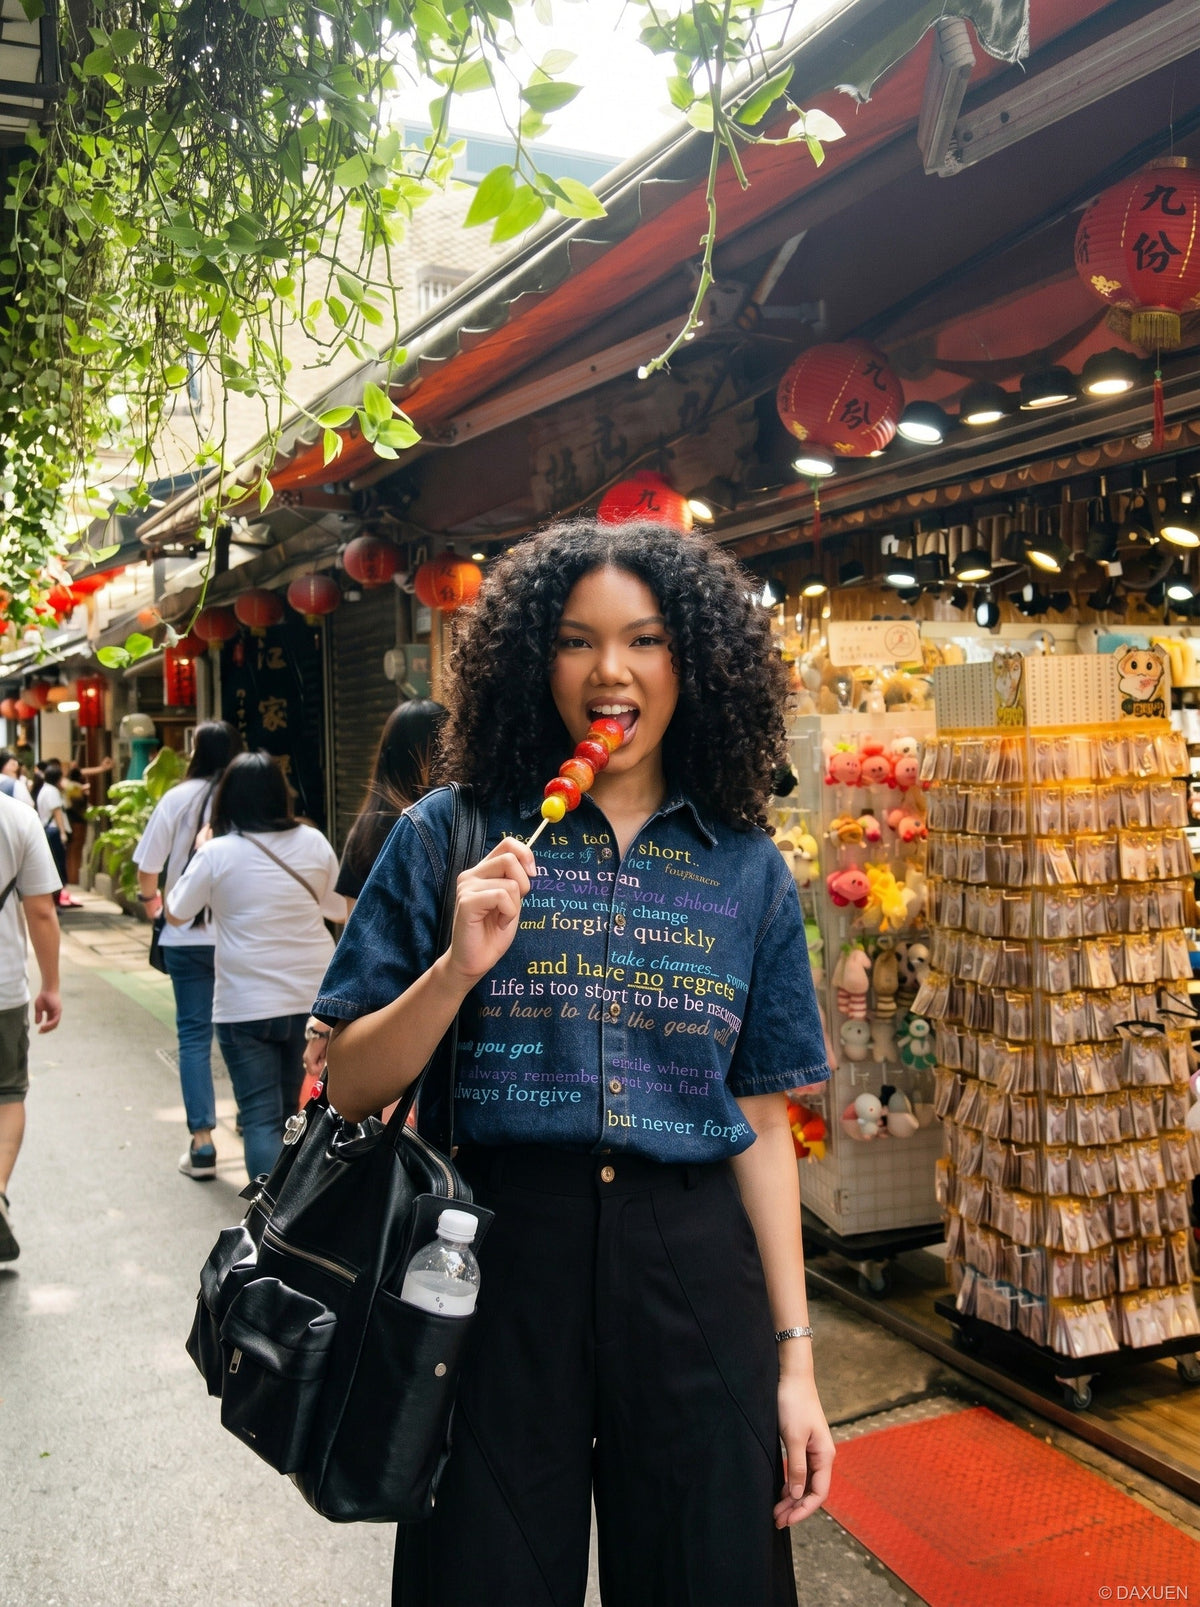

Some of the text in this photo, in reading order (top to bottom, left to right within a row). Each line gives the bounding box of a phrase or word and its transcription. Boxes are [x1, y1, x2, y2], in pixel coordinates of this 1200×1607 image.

[1132, 184, 1187, 273] 九份
[551, 832, 569, 846] is
[553, 868, 591, 880] you
[633, 890, 666, 905] you
[521, 893, 555, 908] what
[560, 899, 588, 912] you
[632, 905, 689, 926] change
[520, 915, 545, 930] and
[634, 926, 716, 954] quickly
[611, 951, 645, 967] take
[527, 953, 568, 975] and
[577, 953, 625, 981] have
[633, 971, 664, 987] no
[672, 975, 735, 1001] regrets
[490, 978, 525, 996] Life
[530, 979, 544, 996] is
[550, 981, 578, 996] too
[634, 991, 652, 1007] to
[658, 991, 679, 1009] be
[684, 993, 704, 1012] be
[509, 1000, 552, 1018] have
[560, 1002, 580, 1019] to
[627, 1011, 656, 1030] the
[474, 1041, 505, 1058] you
[508, 1041, 544, 1060] got
[469, 1065, 518, 1084] always
[657, 1061, 699, 1078] when
[506, 1083, 581, 1107] forgive
[645, 1080, 672, 1094] you
[607, 1109, 749, 1143] but never forget
